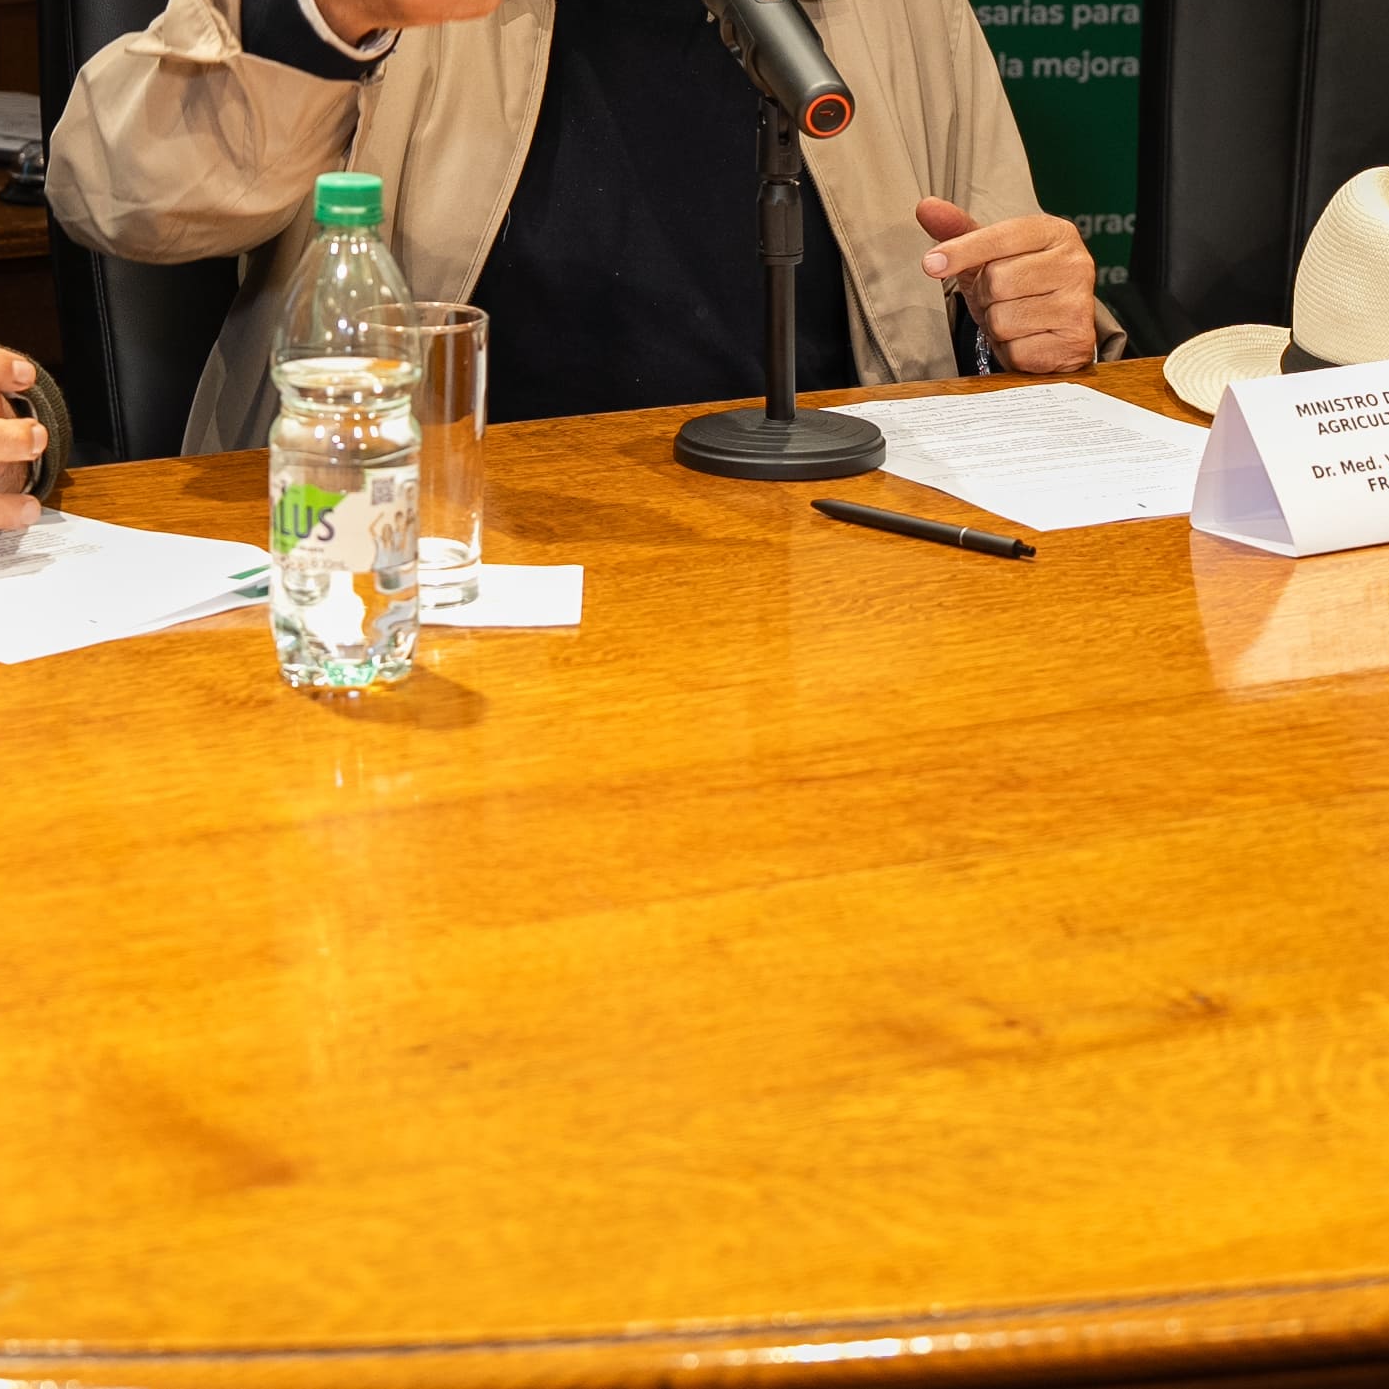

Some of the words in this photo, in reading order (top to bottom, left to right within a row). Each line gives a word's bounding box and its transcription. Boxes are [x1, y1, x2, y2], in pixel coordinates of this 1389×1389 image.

[1072, 3, 1141, 30] para
[1032, 50, 1140, 84] mejora
[1295, 393, 1379, 422] MINISTRO
[1311, 464, 1337, 480] Dr.
[1339, 455, 1383, 475] Med.
[273, 498, 335, 542] LUS
